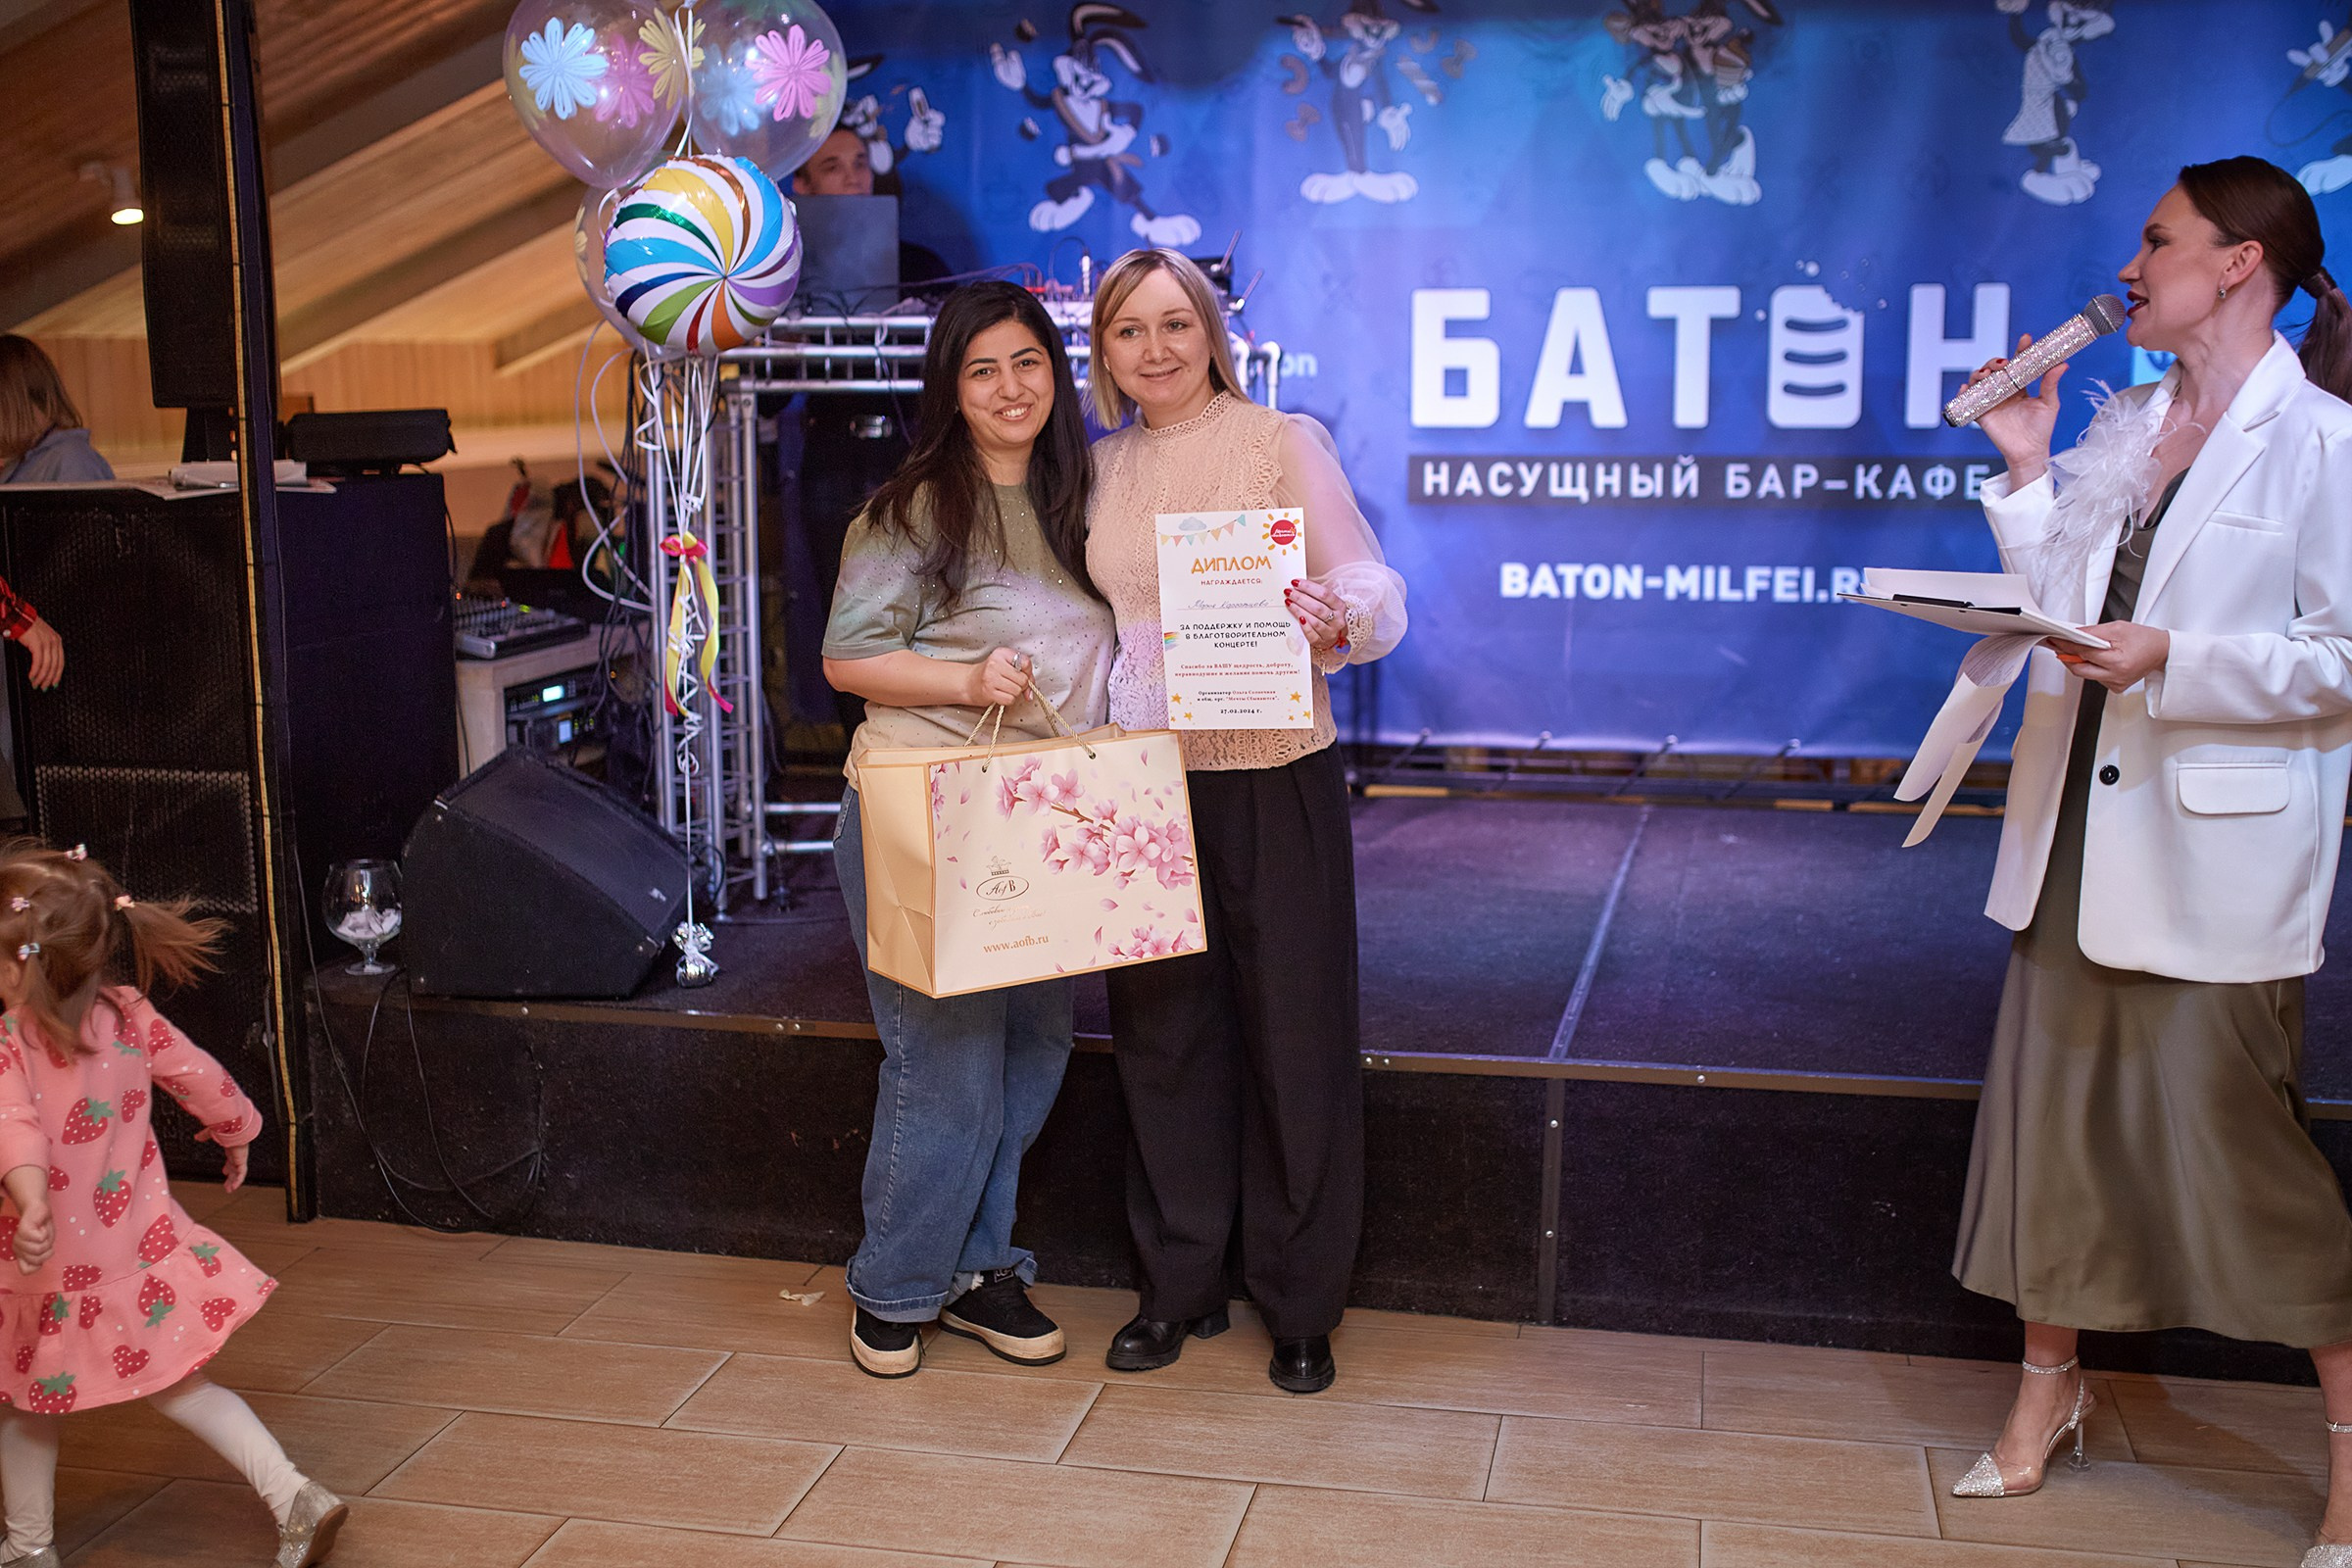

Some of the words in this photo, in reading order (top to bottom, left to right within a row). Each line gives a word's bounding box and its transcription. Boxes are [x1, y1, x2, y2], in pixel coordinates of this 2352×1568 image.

[1423, 455, 1699, 504] НАСУЩНЫЙ
[1191, 555, 1273, 574] ДИПЛОМ
[1499, 562, 1868, 604] BATON-MILFEI.R
[1193, 630, 1287, 640] БЛАГОТВОРИТЕЛЬНОМ
[1213, 640, 1258, 649] КОНЦЕРТЕ!
[983, 935, 1050, 954] www.aofb.ru
